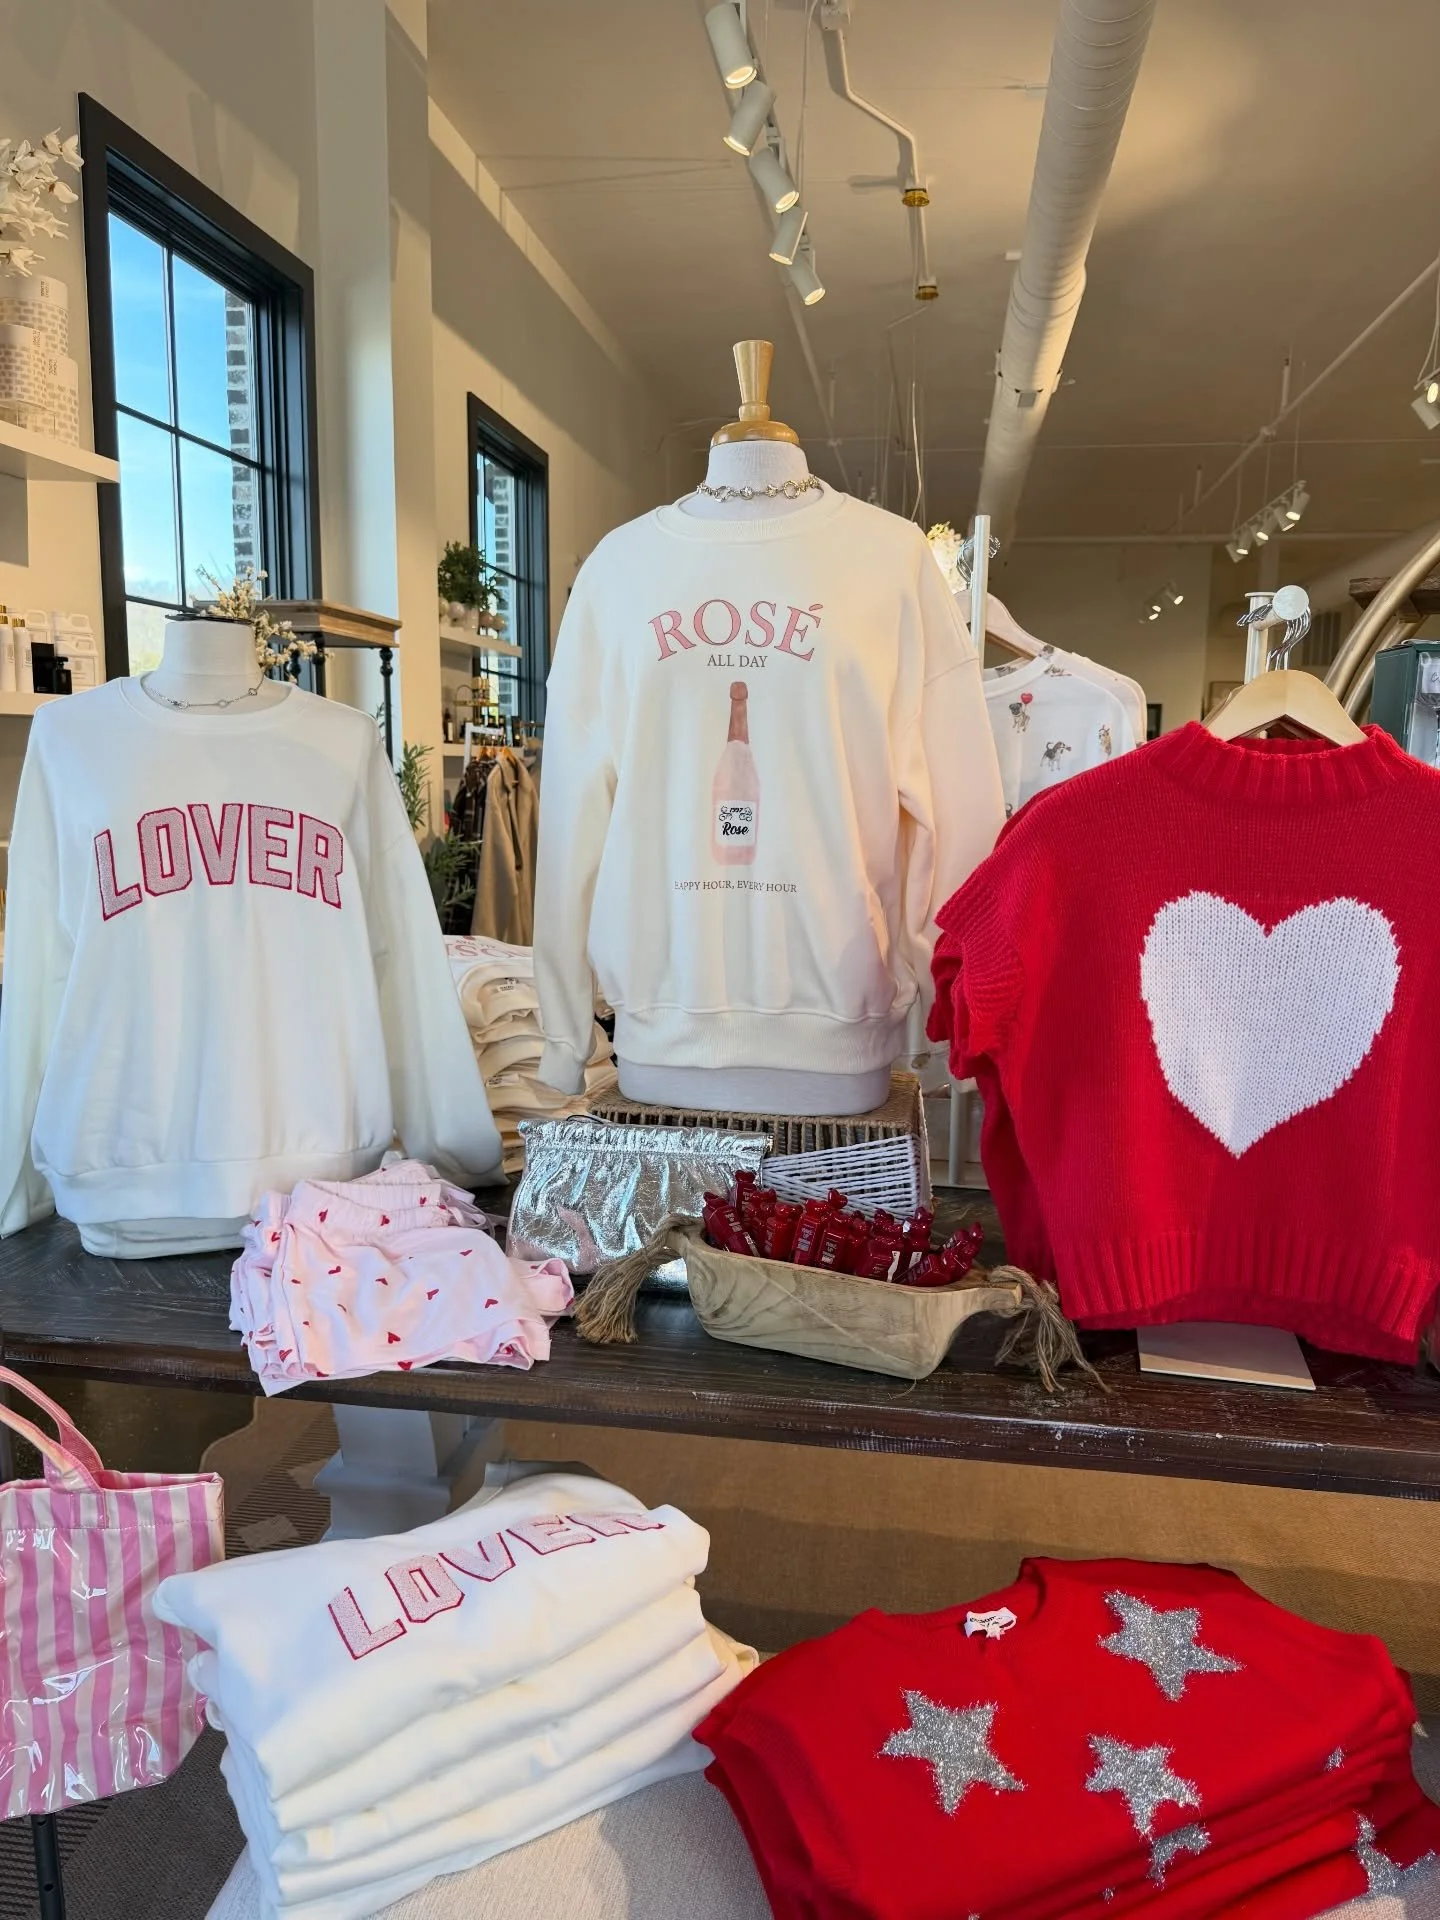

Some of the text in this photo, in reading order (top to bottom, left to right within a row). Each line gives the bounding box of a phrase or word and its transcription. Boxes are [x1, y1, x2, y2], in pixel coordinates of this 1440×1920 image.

[648, 599, 823, 661] ROSÉ
[707, 654, 768, 668] ALL DAY
[722, 822, 749, 836] Rose
[94, 803, 344, 921] LOVER
[703, 880, 735, 890] HOUR,
[737, 880, 765, 891] EVERY
[766, 883, 797, 893] HOUR
[327, 1511, 667, 1660] LOVER
